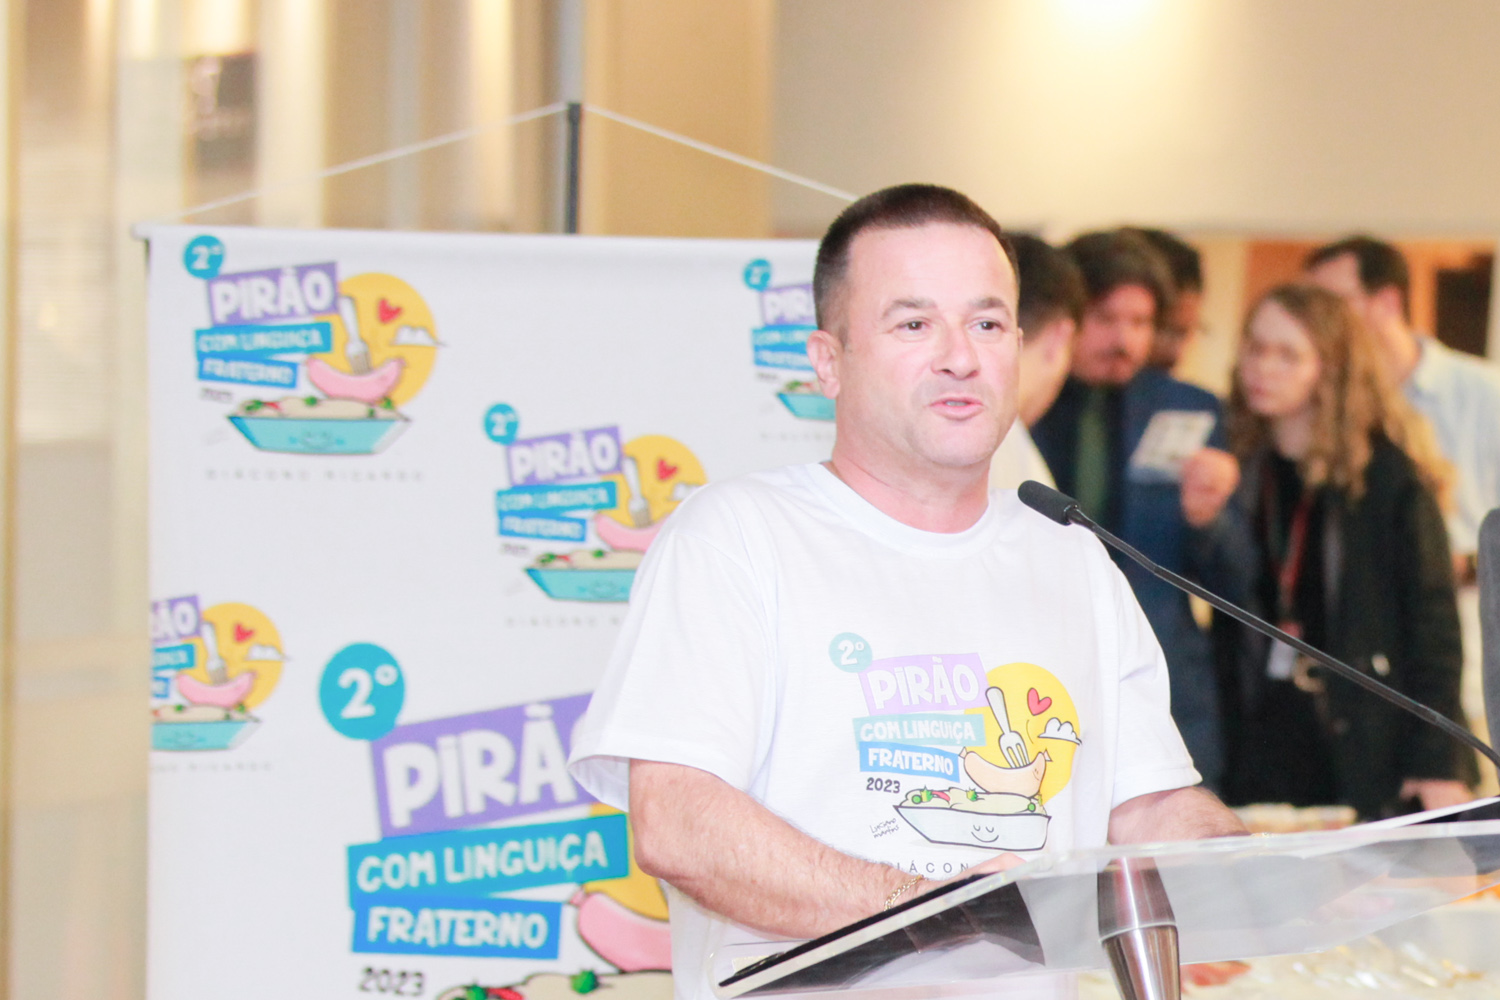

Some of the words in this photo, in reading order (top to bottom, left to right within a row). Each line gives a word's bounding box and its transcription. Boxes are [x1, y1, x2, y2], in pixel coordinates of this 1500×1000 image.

[211, 266, 334, 323] PIRÃO
[866, 656, 980, 710] PIRÃO
[860, 723, 900, 741] COM
[903, 720, 976, 744] LINGUIÇA
[383, 704, 581, 829] PIRÃ
[868, 748, 954, 775] FRATERNO
[866, 778, 900, 794] 2023
[356, 850, 437, 893] COM
[444, 831, 609, 883] LINGUIÇA
[897, 860, 969, 873] IÁCON
[367, 906, 548, 949] FRATERNO
[359, 967, 425, 997] 2023
